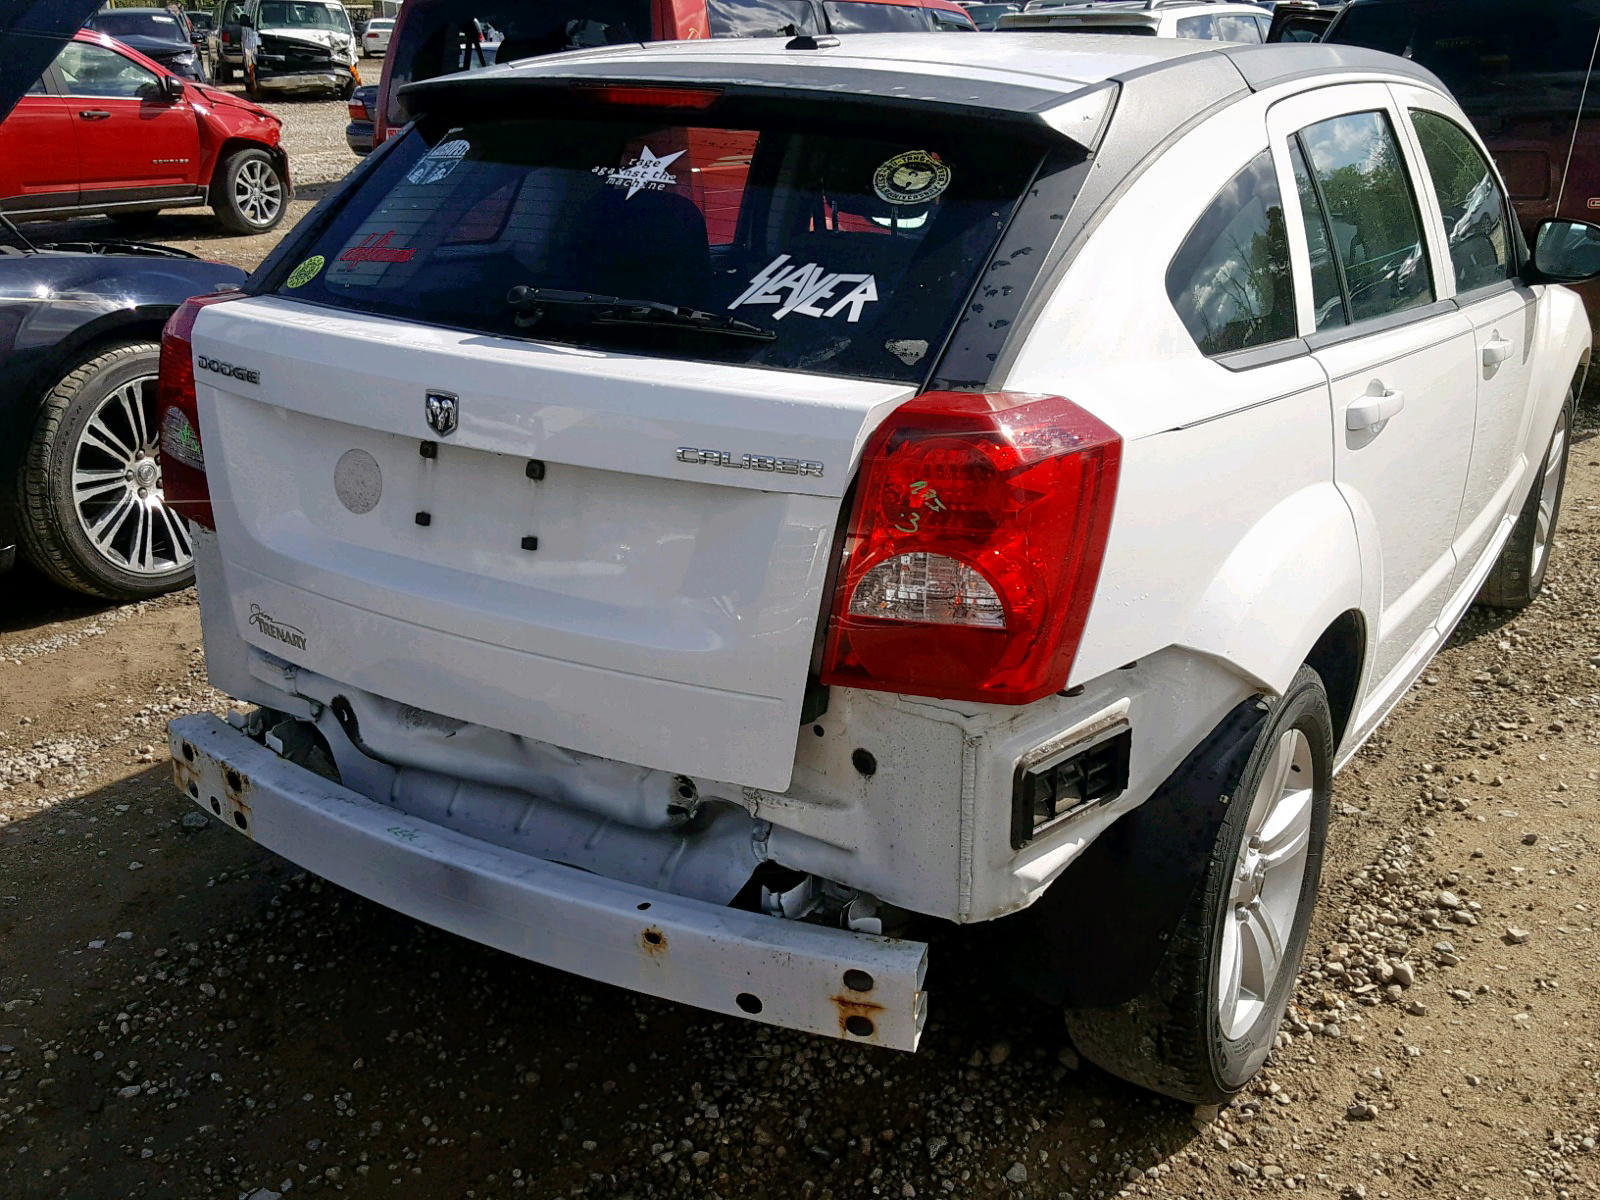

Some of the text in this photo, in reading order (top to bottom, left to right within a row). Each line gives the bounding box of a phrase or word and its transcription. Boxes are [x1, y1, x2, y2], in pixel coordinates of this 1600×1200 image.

[629, 158, 661, 169] rage
[653, 170, 677, 181] the
[605, 177, 666, 191] machine
[727, 254, 878, 322] SLAYER
[198, 355, 260, 385] DODGE
[676, 446, 824, 478] CALIBER
[256, 616, 306, 651] TRENARY
